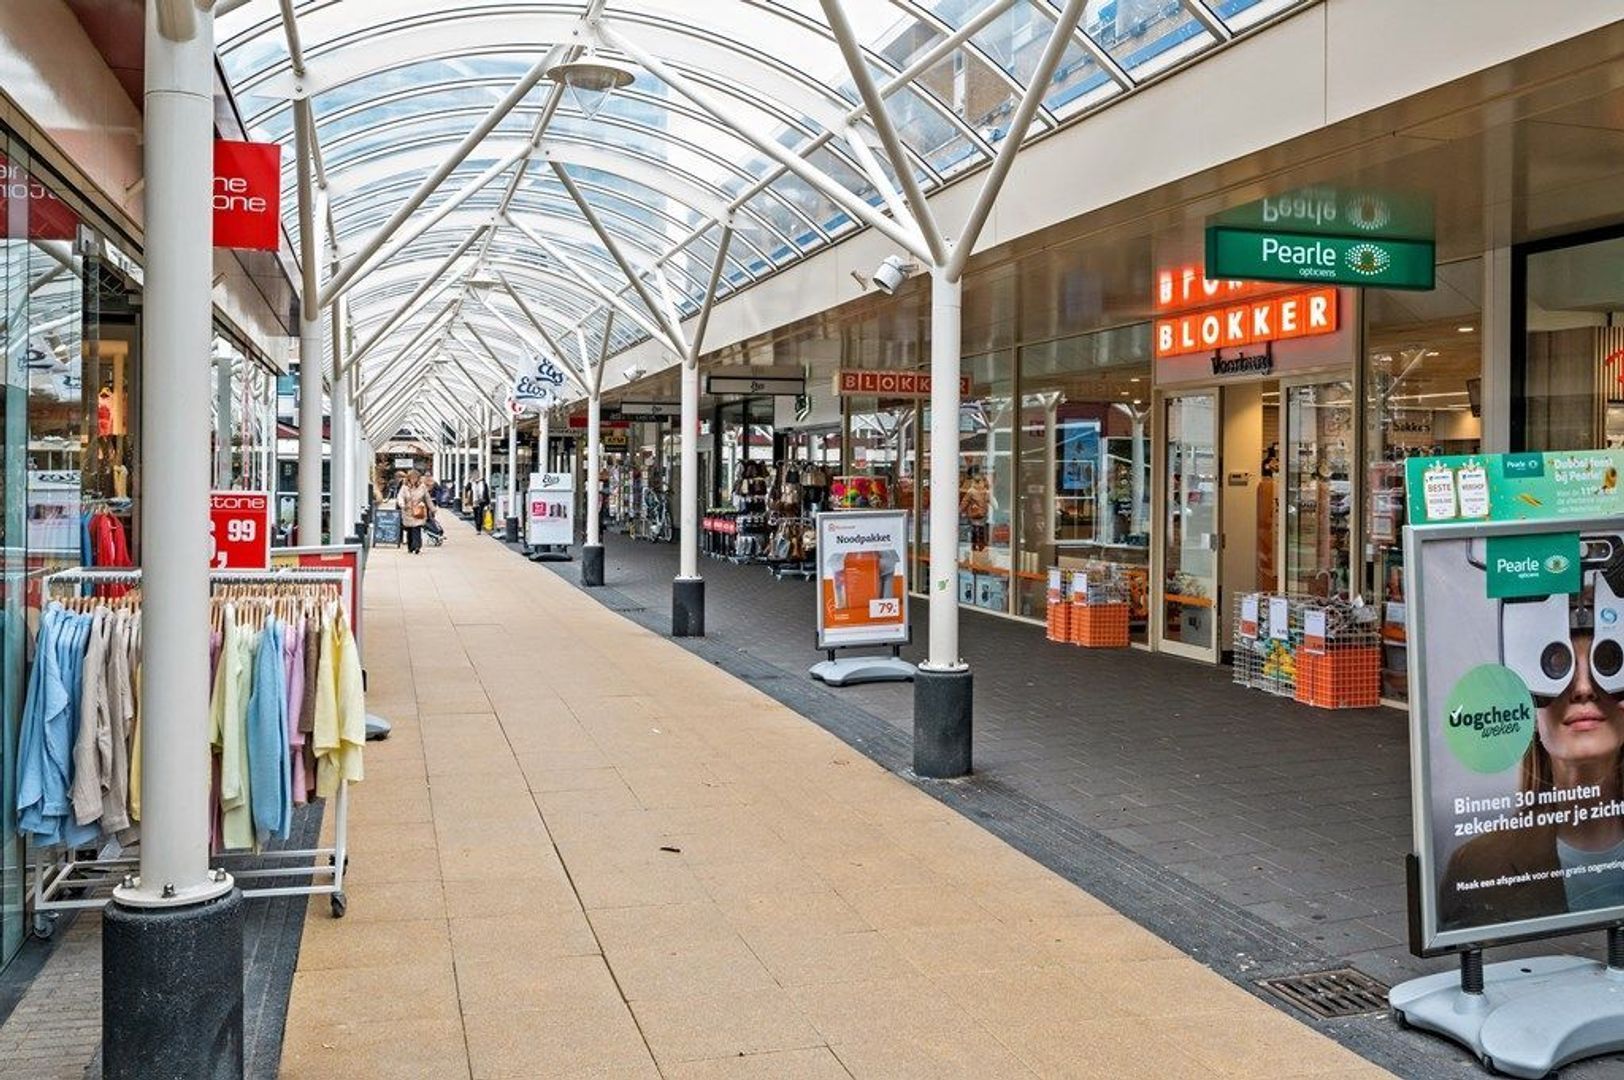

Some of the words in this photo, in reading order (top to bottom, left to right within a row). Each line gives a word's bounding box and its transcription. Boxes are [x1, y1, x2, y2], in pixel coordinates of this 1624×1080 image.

[1262, 238, 1336, 266] Pearle
[1299, 267, 1336, 278] opticiens
[1159, 296, 1327, 351] BLOKKER
[845, 375, 966, 393] BLOKKR
[1427, 484, 1452, 492] BESTE
[209, 496, 265, 509] tone
[836, 533, 892, 545] Noodpakket
[1497, 557, 1539, 573] Pearle
[1481, 722, 1521, 738] weken
[1454, 796, 1511, 815] Binnen
[1515, 790, 1535, 808] 30
[1538, 784, 1601, 805] minuten
[1454, 811, 1533, 837] zekerheid
[1537, 810, 1571, 826] over
[1572, 805, 1588, 826] je
[1456, 880, 1480, 891] Maak
[1480, 879, 1495, 888] een
[1496, 872, 1532, 887] afspraak
[1532, 871, 1549, 880] voor
[1550, 868, 1565, 878] een
[1565, 864, 1587, 878] gratis
